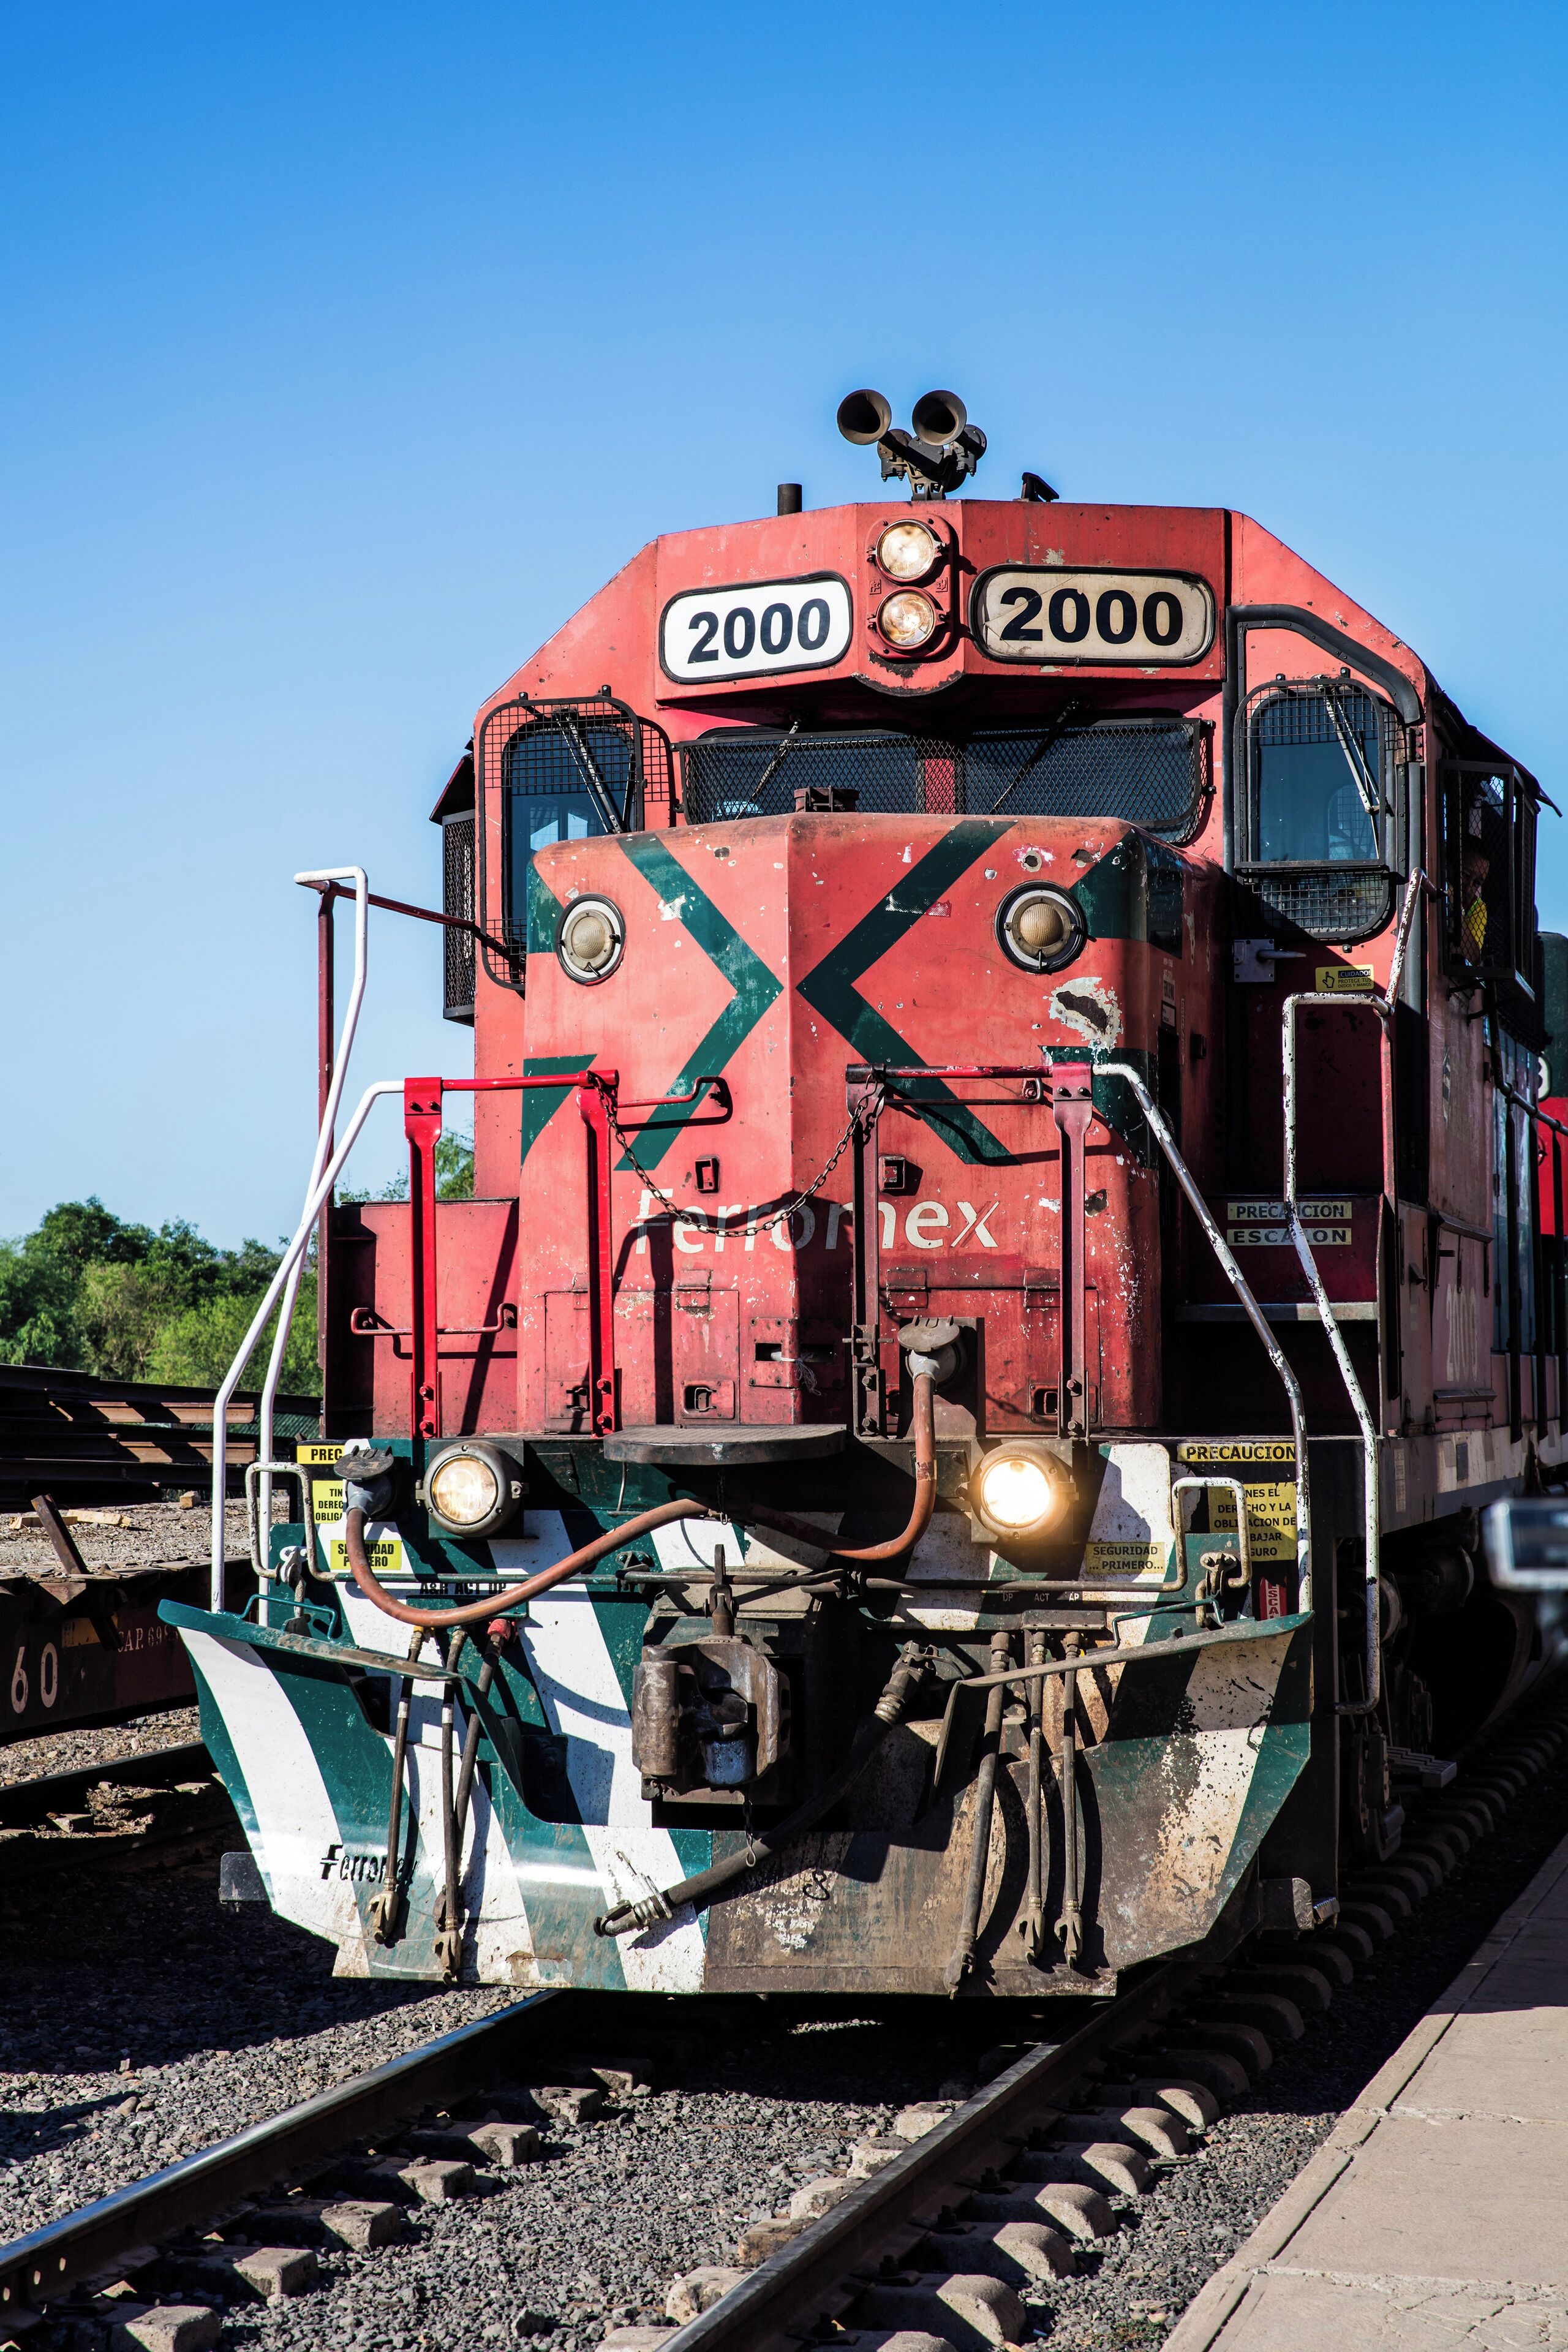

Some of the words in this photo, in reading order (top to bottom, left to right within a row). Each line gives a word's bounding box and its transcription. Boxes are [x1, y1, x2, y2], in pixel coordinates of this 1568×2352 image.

[1000, 587, 1183, 647] 2000
[687, 598, 831, 665] 2000
[1237, 1205, 1344, 1218] PRECCION
[627, 1187, 1000, 1254] Ferromex
[1234, 1230, 1346, 1243] ESCAON
[1186, 1446, 1295, 1460] PRECAUCION
[1228, 1489, 1265, 1498] TNES
[1268, 1488, 1280, 1497] EL
[1218, 1503, 1267, 1513] DERCHO
[1269, 1503, 1276, 1512] Y
[1279, 1502, 1292, 1511] LA
[1214, 1517, 1280, 1528] OBLIACION
[1283, 1517, 1296, 1526] DE
[1093, 1546, 1158, 1555] SEGURIDAD
[454, 1582, 480, 1594] ACT
[1003, 1593, 1013, 1602] DP
[1034, 1593, 1050, 1602] ACT
[1069, 1592, 1079, 1602] AP
[11, 1641, 59, 1714] 60
